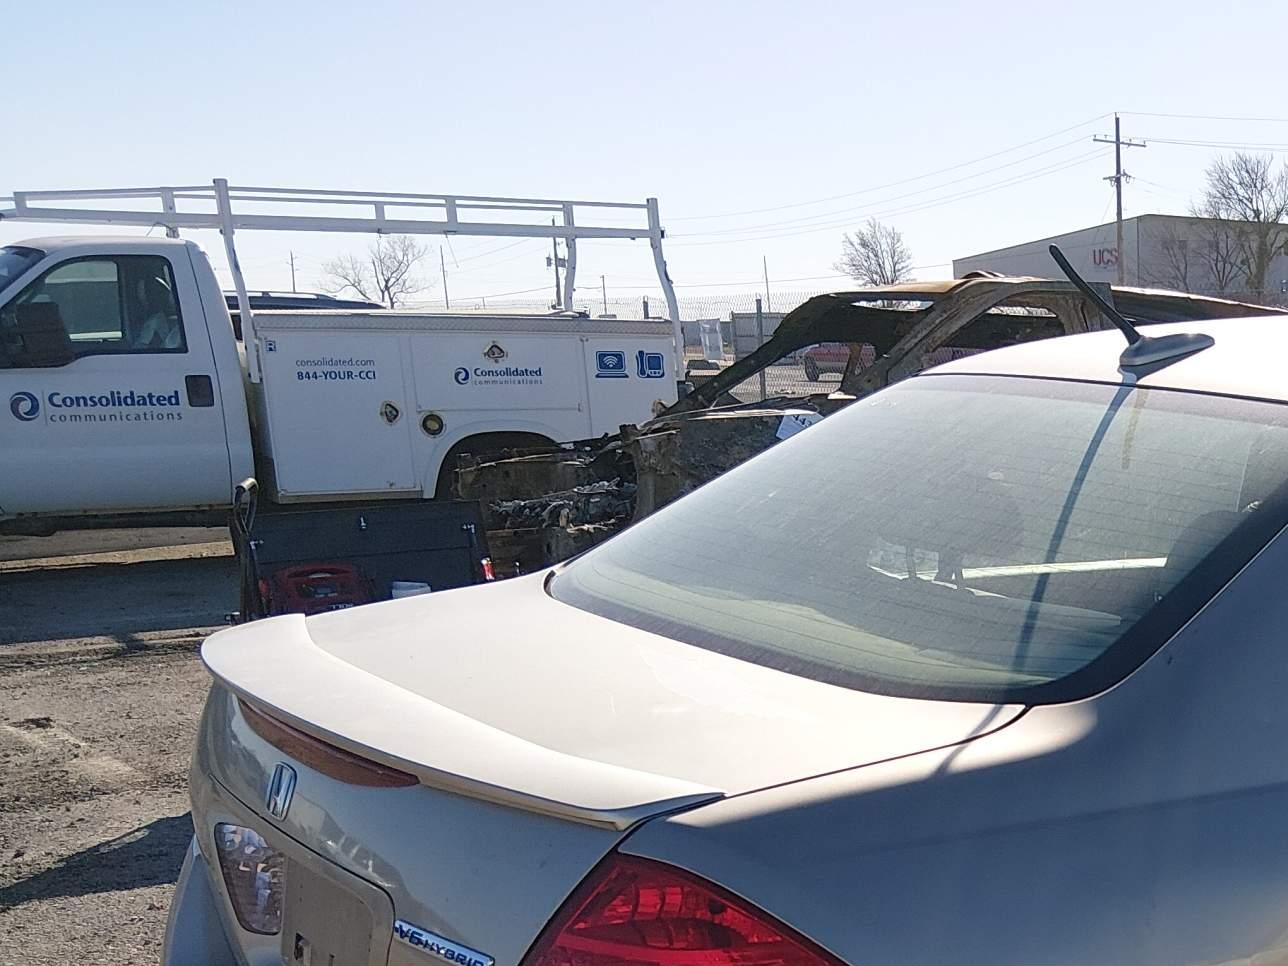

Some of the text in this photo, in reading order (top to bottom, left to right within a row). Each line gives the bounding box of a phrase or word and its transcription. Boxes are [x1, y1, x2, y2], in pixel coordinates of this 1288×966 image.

[295, 357, 375, 367] consolidated.com
[296, 370, 376, 381] 844-YOUR-CCI
[473, 367, 542, 377] Consolidated
[48, 390, 181, 408] Consolidated
[49, 411, 183, 423] communications
